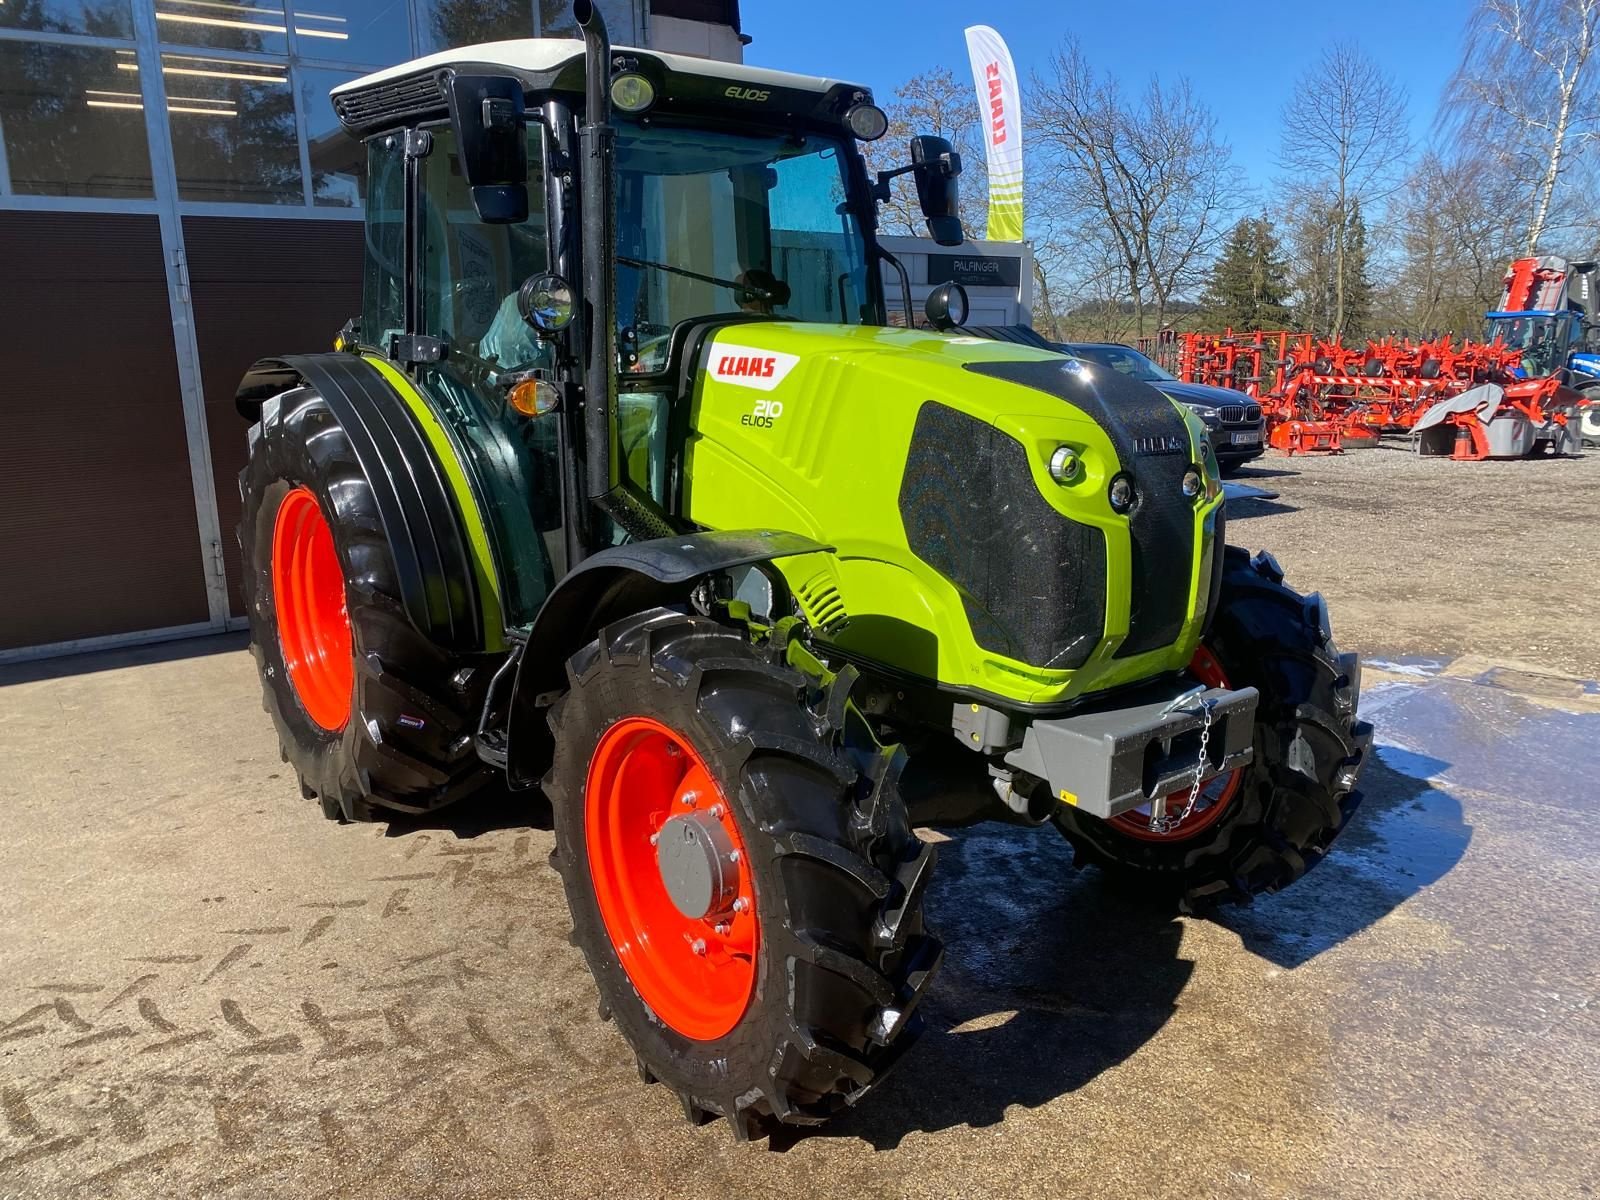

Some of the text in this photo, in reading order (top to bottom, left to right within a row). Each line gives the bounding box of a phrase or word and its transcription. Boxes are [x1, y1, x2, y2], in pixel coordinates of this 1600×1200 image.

[724, 86, 771, 102] ELIOS
[986, 61, 1007, 146] CLAAS
[953, 260, 999, 273] PALFINGER
[717, 356, 776, 377] CLAAS
[753, 400, 783, 418] 210
[741, 414, 774, 429] ELIOS
